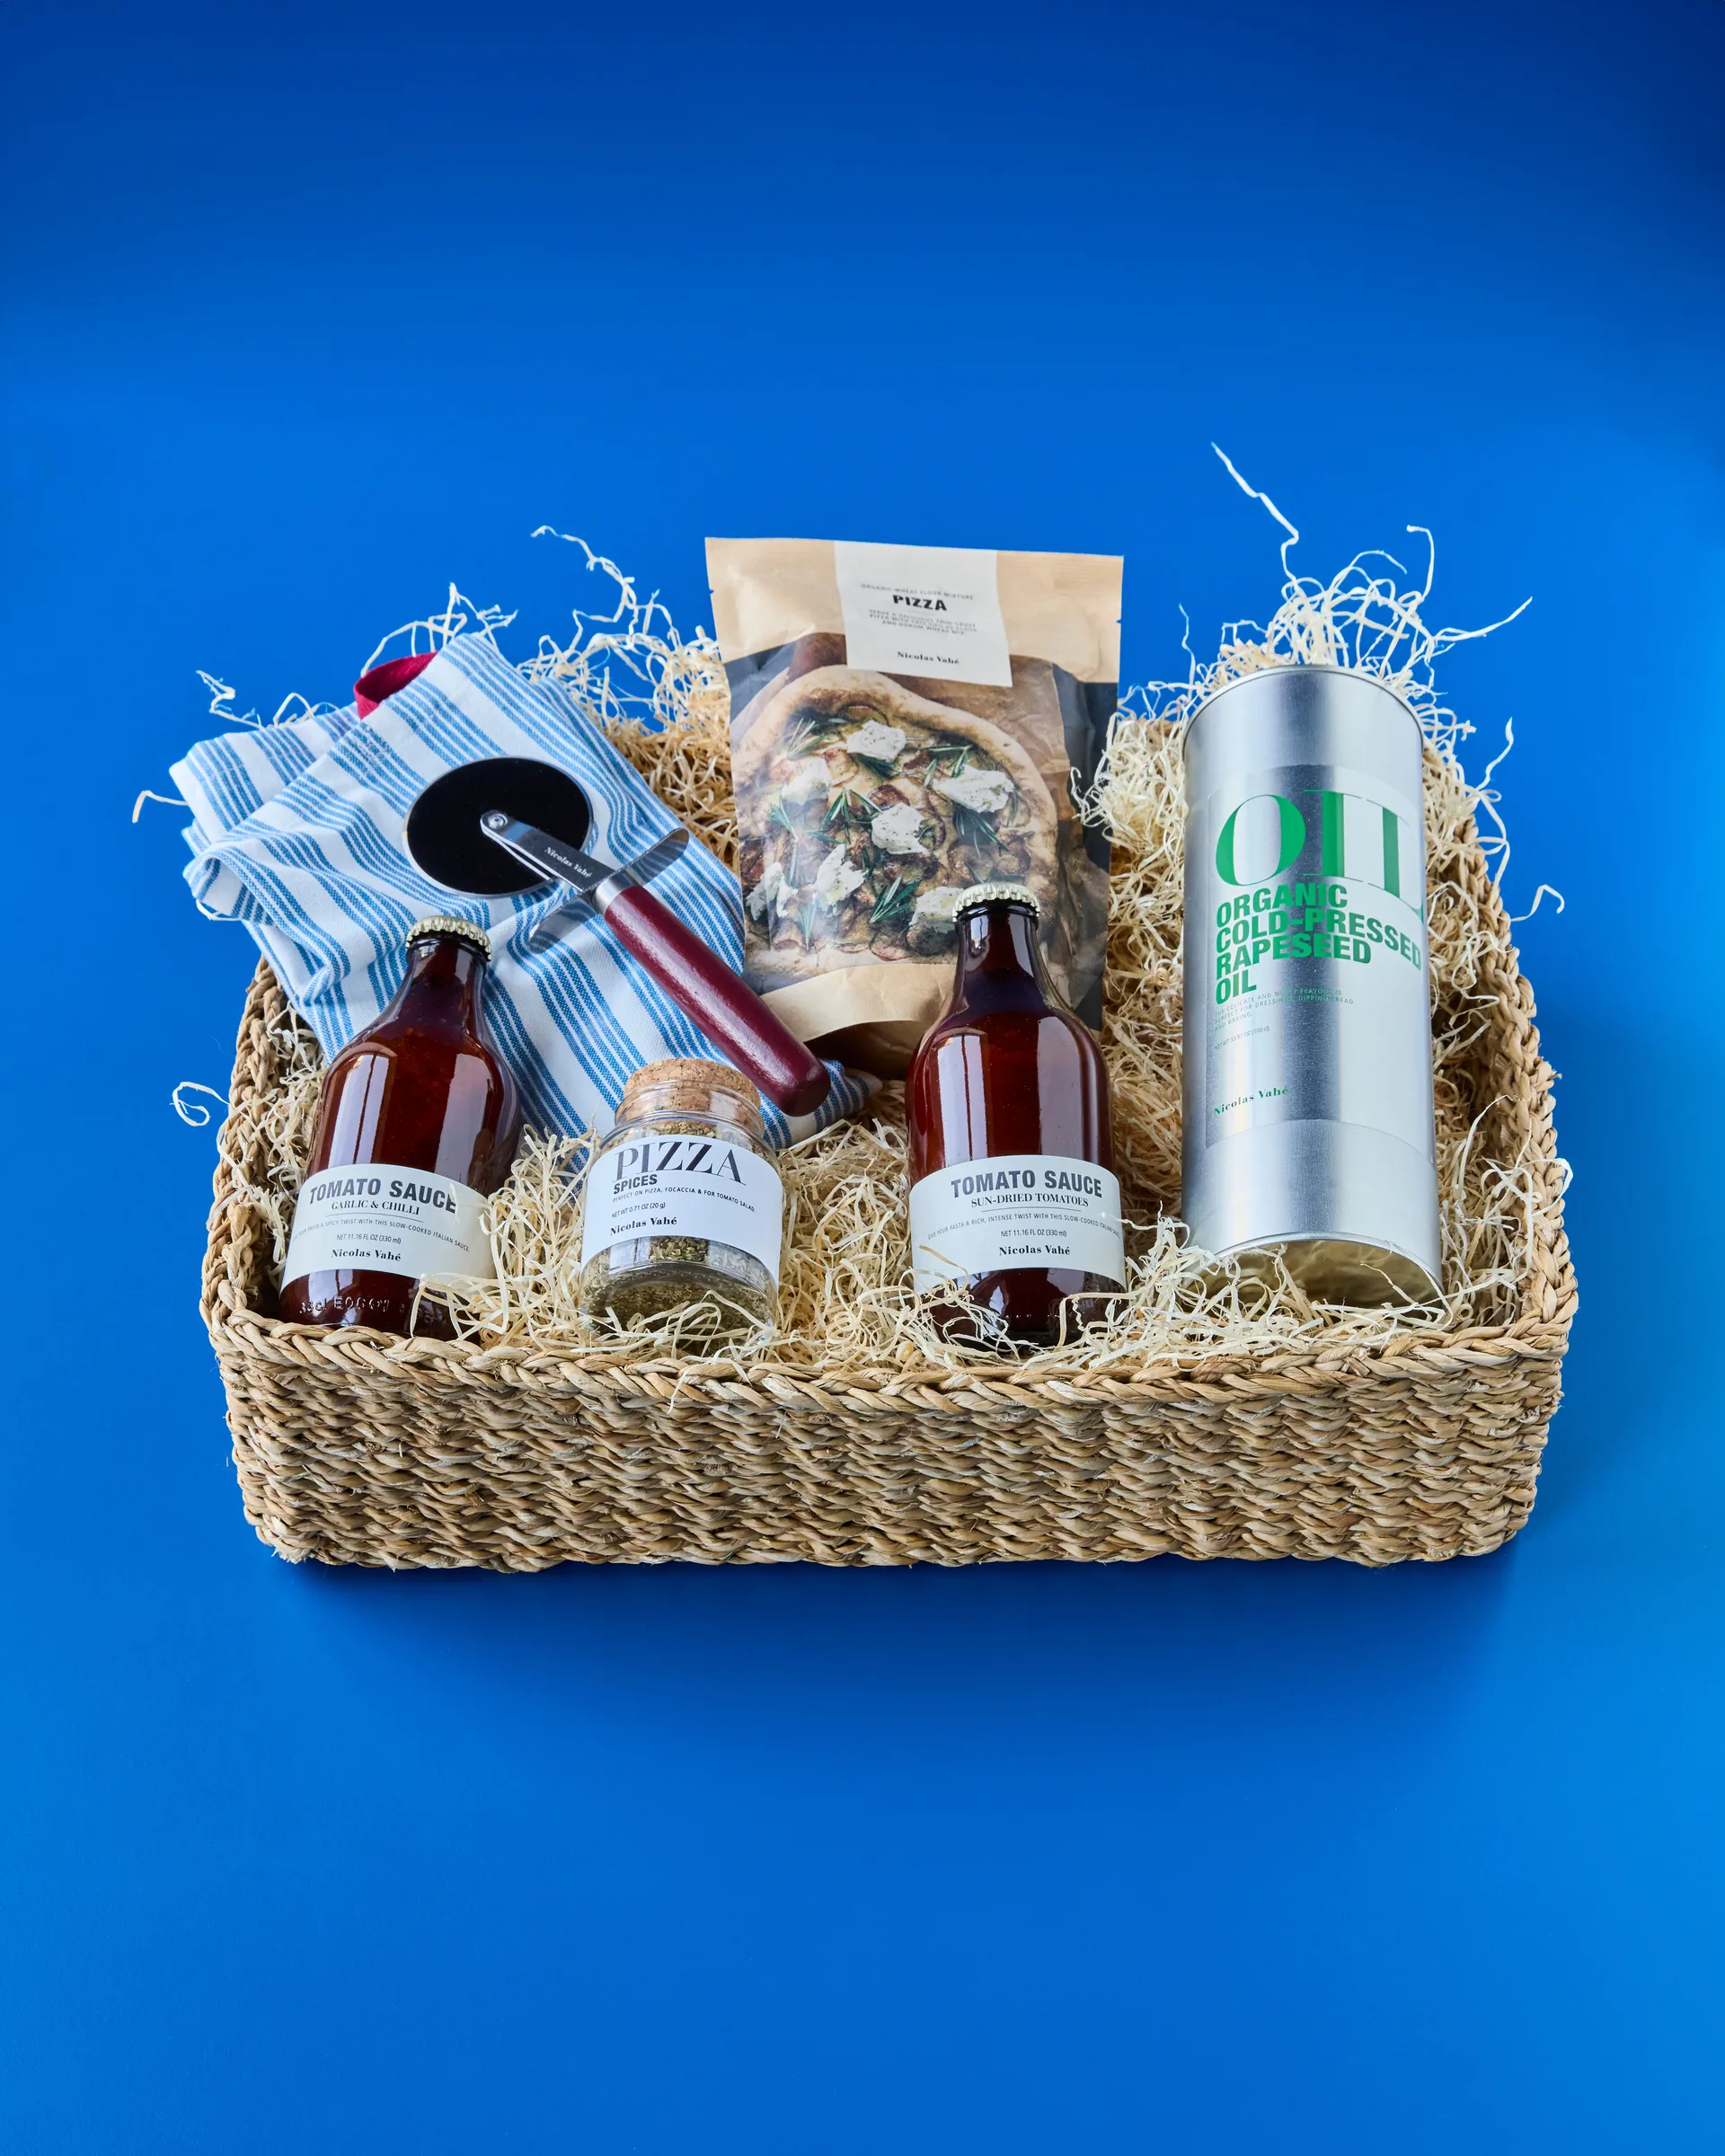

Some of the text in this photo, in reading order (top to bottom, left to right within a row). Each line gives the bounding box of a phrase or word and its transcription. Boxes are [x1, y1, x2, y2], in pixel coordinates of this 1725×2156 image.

[893, 595, 947, 611] PIZZA
[943, 592, 973, 600] MIXTURE
[898, 651, 960, 665] Nicolas Vahé
[544, 846, 593, 878] Nicolas Vahé
[1216, 789, 1424, 923] OIL
[1216, 882, 1348, 928] ORGANIC
[1216, 907, 1421, 971] COLD-PRESSED
[1216, 932, 1372, 980] RAPESEED
[1216, 968, 1257, 1005] OIL
[1227, 996, 1254, 1012] DELICATE
[1258, 992, 1271, 1000] AND
[1214, 1085, 1289, 1115] Nicolas Vahé
[612, 1141, 747, 1186] PIZZA
[613, 1173, 658, 1195] SPICES
[951, 1170, 1102, 1198] TOMATO SAUCE
[309, 1178, 457, 1214] TOMATO SAUCE
[613, 1192, 632, 1203] PERFECT
[717, 1192, 739, 1204] TOMATO
[971, 1192, 1089, 1207] SUN-DRIED TOMATOES
[332, 1199, 420, 1215] GARLIC & CHILLI
[611, 1210, 620, 1218] NET
[629, 1205, 640, 1213] 0.71
[610, 1216, 677, 1236] Nicolas Vahé
[937, 1226, 948, 1234] YOUR
[950, 1223, 965, 1231] PASTA
[988, 1214, 1013, 1223] INTENSE
[1064, 1215, 1098, 1226] SLOW-COOKED
[1046, 1229, 1058, 1237] (330
[379, 1234, 392, 1242] (330
[393, 1237, 401, 1245] ml)
[389, 1221, 431, 1235] SLOW-COOKED
[433, 1231, 453, 1243] ITALIAN
[455, 1240, 471, 1252] SAUCE.
[331, 1249, 402, 1261] Nicolas Vahé
[999, 1245, 1071, 1256] Nicolas Vahé
